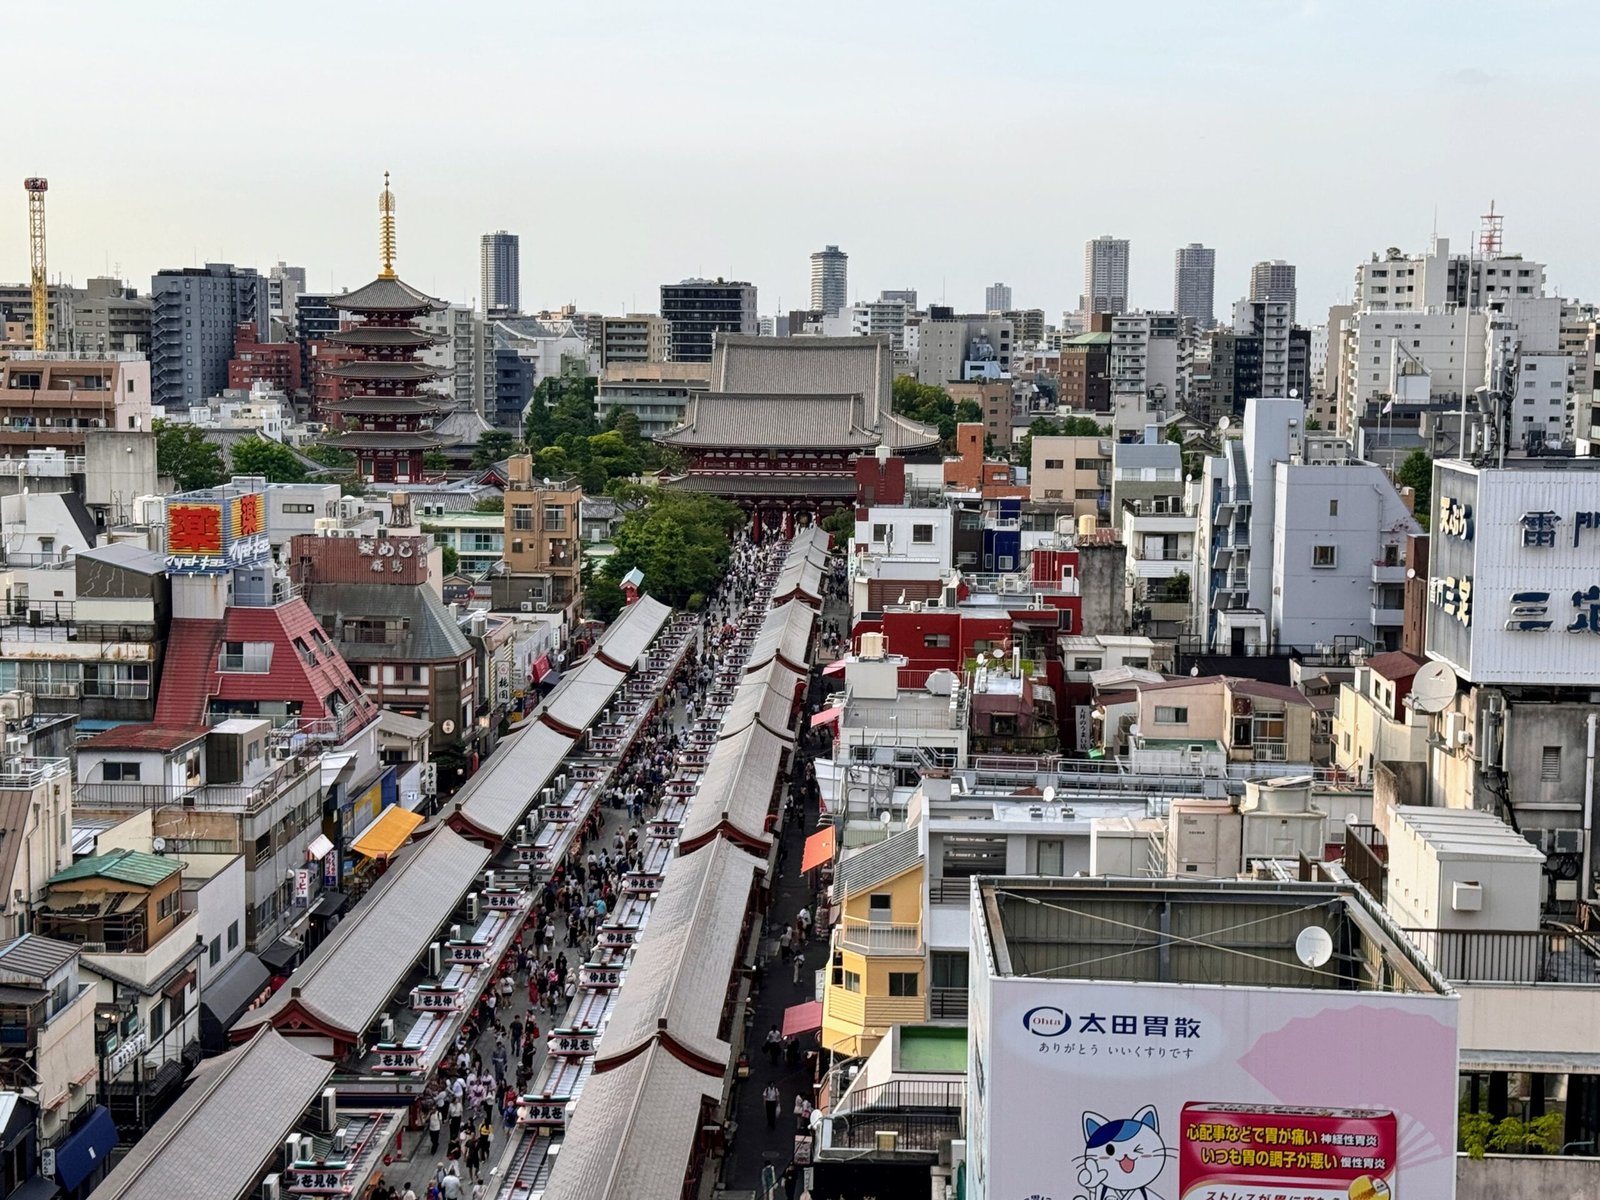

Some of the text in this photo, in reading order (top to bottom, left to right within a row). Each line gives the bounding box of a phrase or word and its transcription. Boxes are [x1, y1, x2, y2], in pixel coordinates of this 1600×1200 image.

[240, 494, 258, 536] 薬
[1439, 495, 1474, 542] 天ぷら
[169, 505, 222, 552] 薬
[358, 540, 413, 558] 釜めし
[299, 871, 307, 894] コーヒー
[1032, 1017, 1062, 1026] Ohta
[1079, 1012, 1201, 1039] 太田胃散
[1039, 1041, 1194, 1060] ありがとう いいくすりです
[1186, 1123, 1378, 1147] 心配事などで胃が痛い 神経性胃炎
[1201, 1147, 1386, 1169] いつも胃の調子が悪い 慢性胃炎
